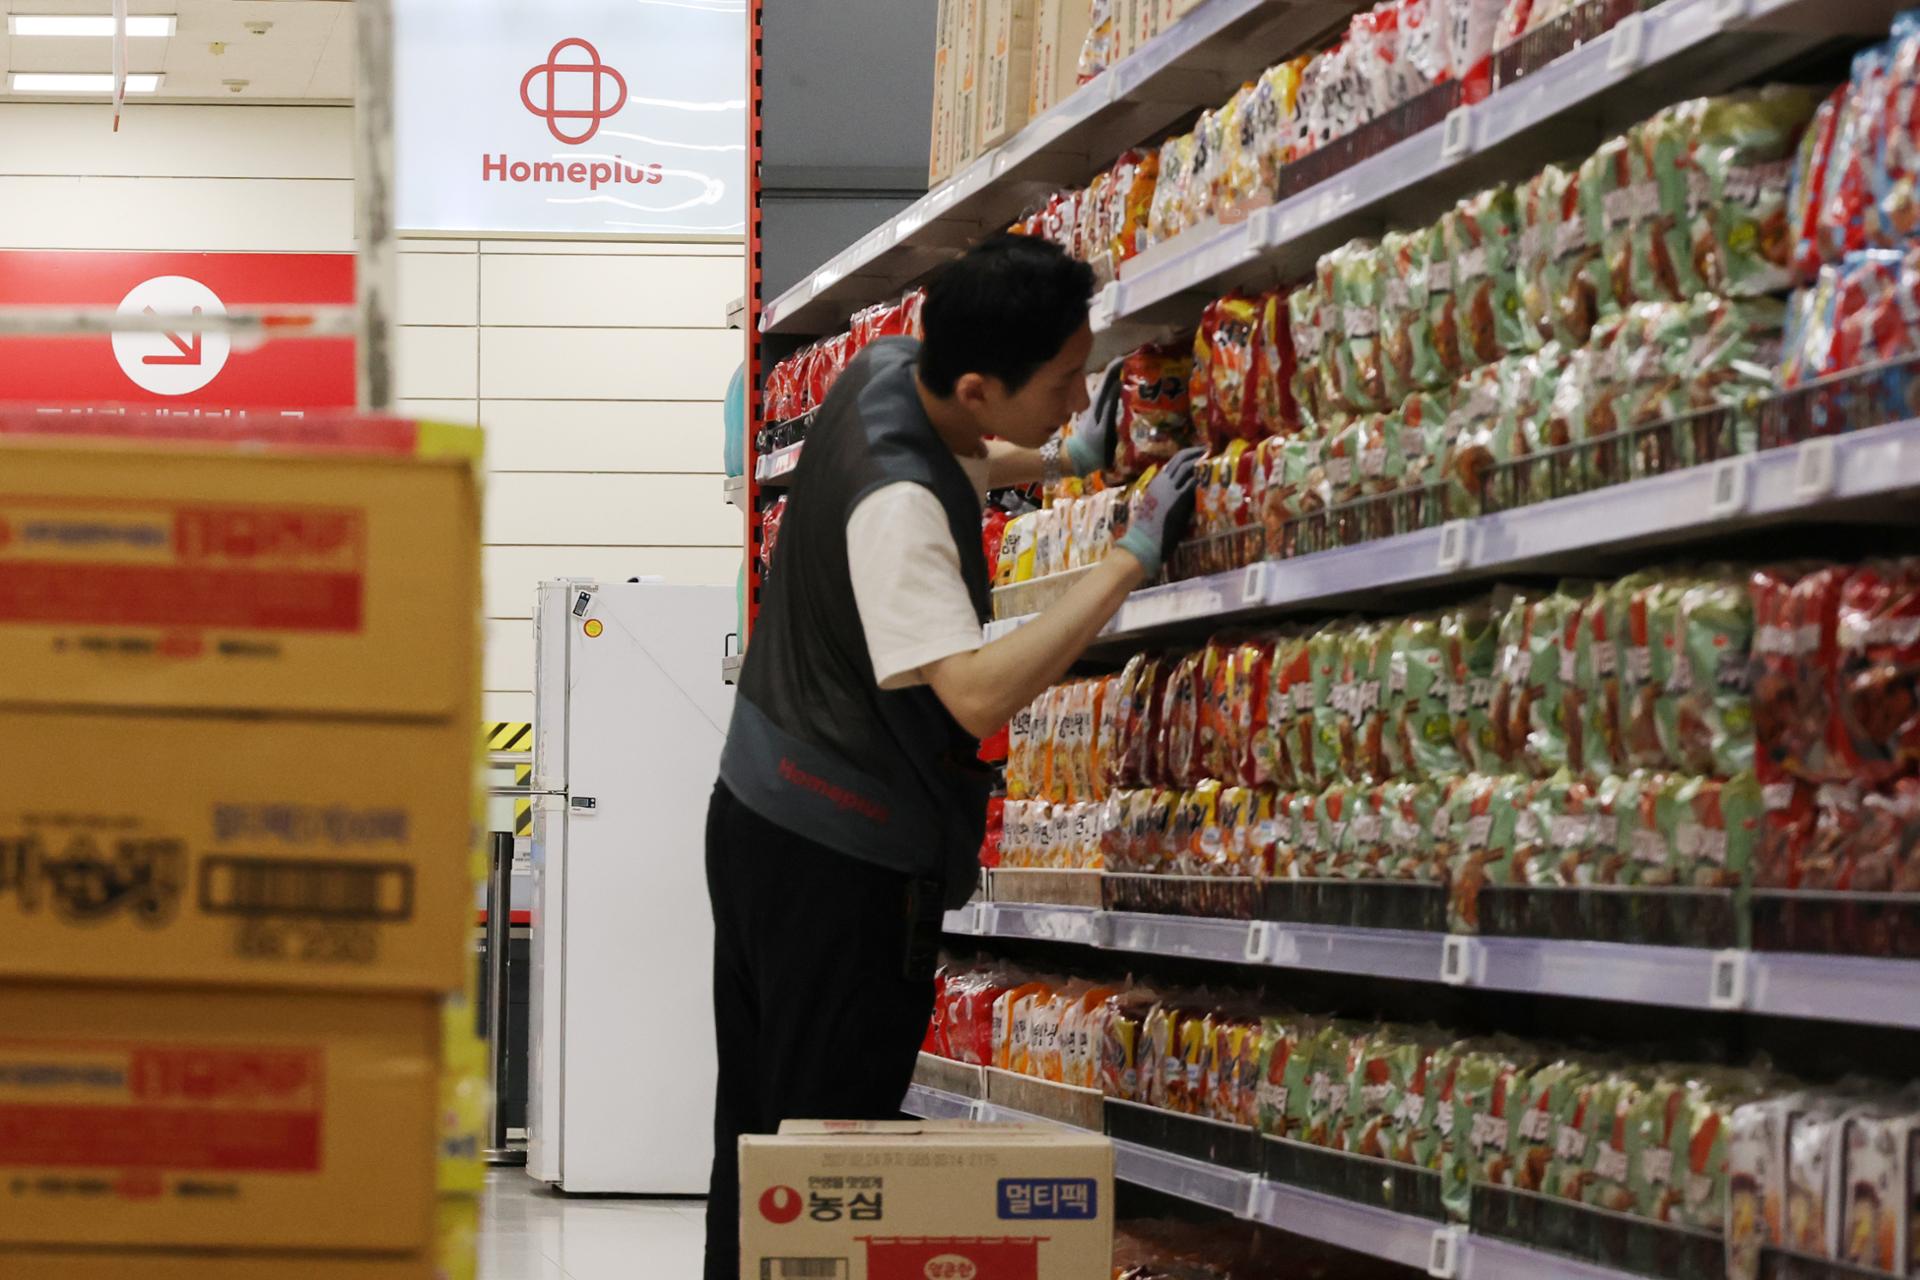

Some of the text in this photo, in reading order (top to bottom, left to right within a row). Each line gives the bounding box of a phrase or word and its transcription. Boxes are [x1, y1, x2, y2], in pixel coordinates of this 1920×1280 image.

[482, 154, 663, 190] Homeplus
[808, 1192, 883, 1221] 농심
[1006, 1183, 1089, 1213] 멀티팩
